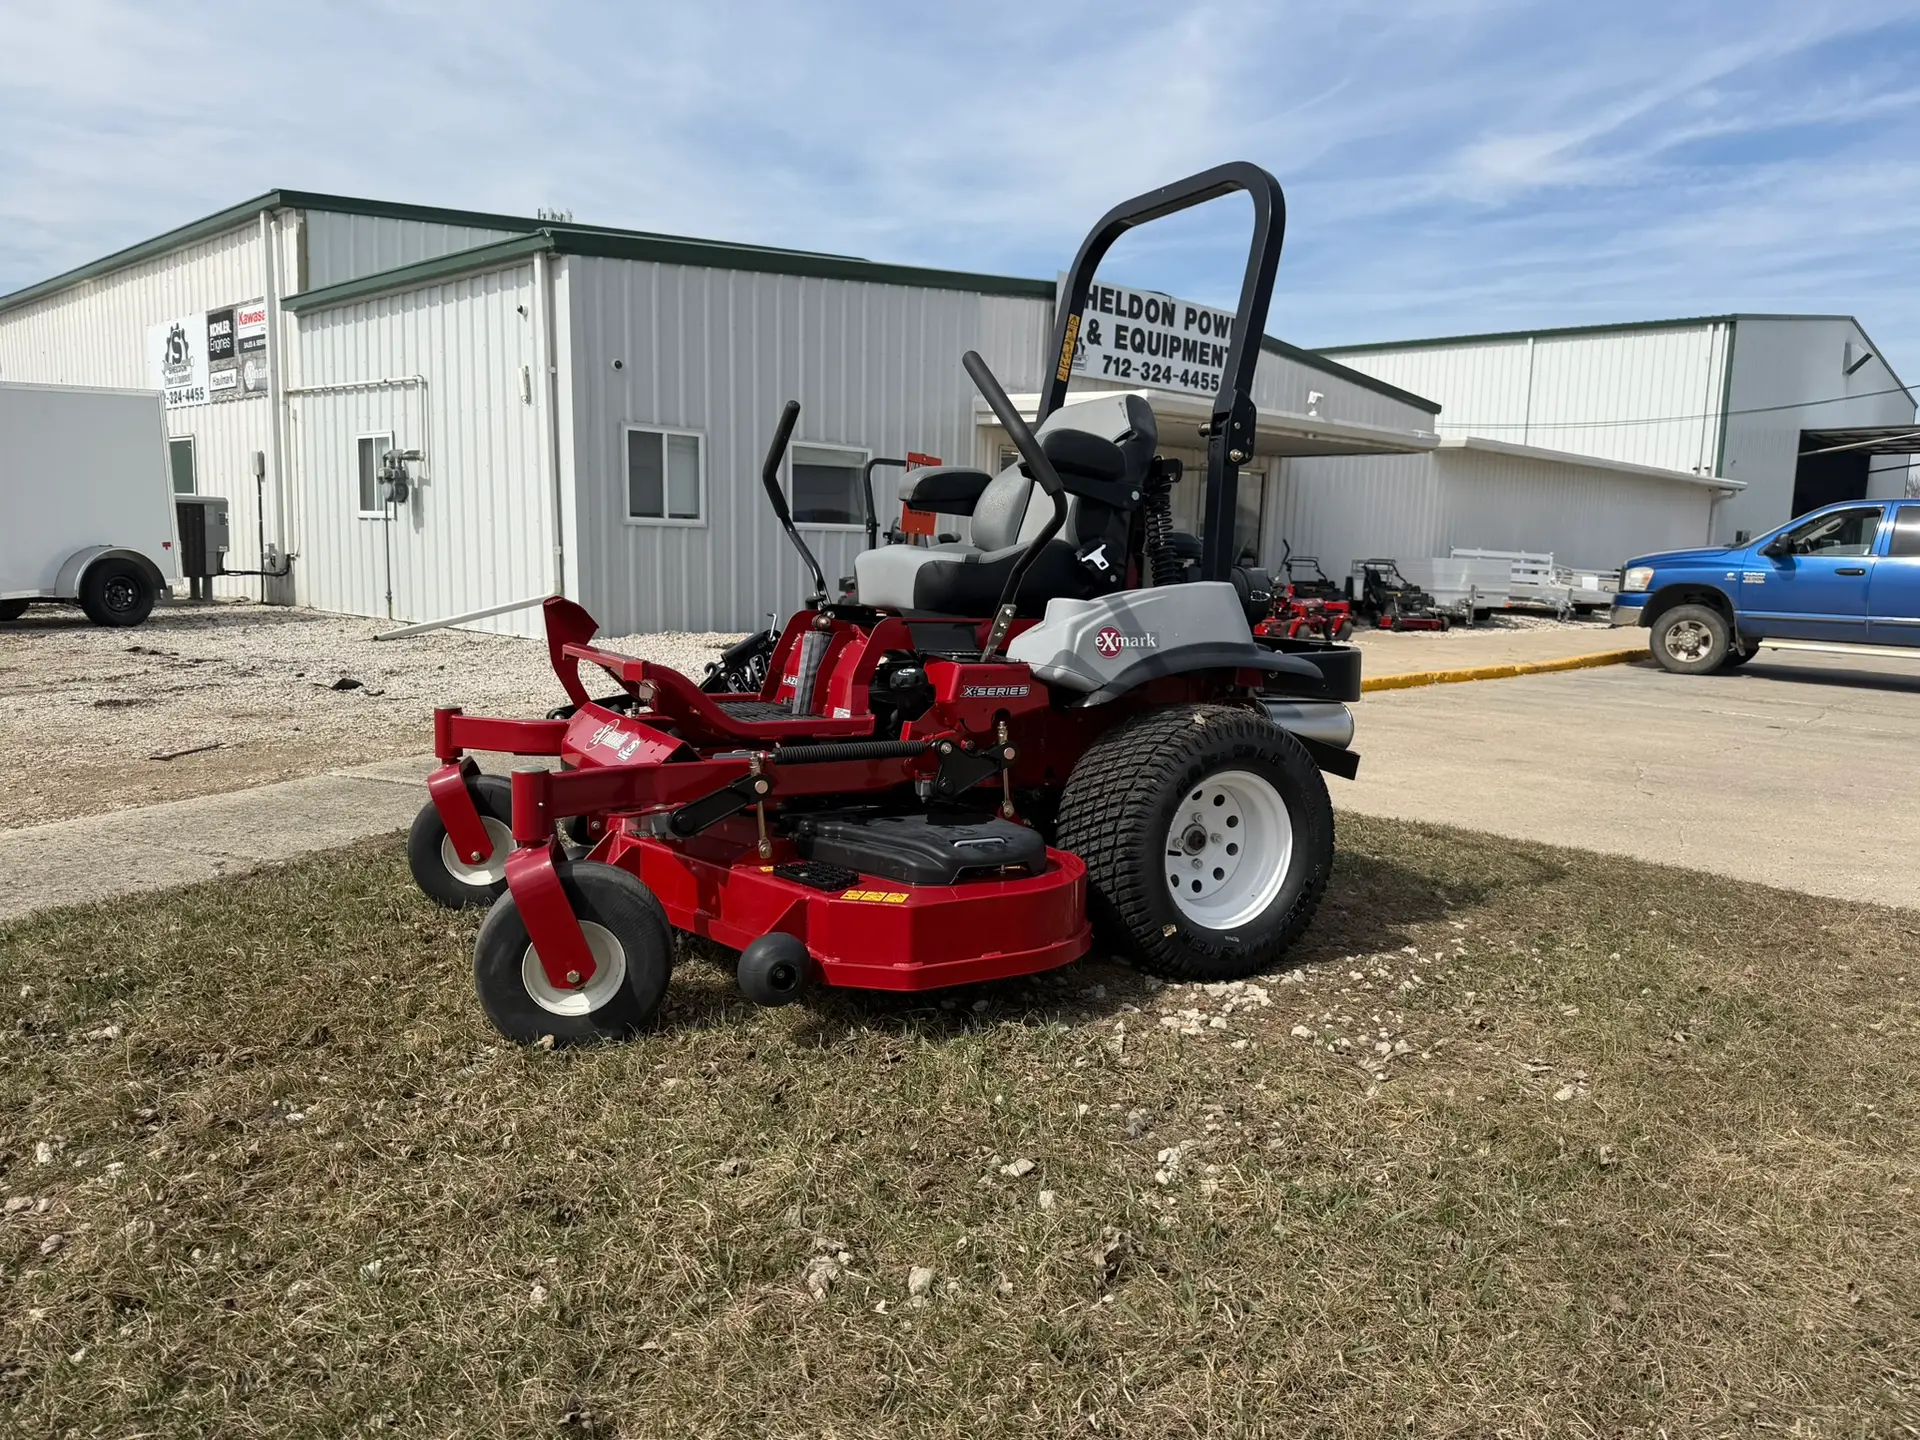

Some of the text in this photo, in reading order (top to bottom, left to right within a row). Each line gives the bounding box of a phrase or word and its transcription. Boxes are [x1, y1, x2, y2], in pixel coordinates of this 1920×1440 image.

[1085, 285, 1176, 328] HELDON
[209, 336, 231, 353] Engines
[1087, 319, 1102, 347] &
[1103, 355, 1220, 392] 712-324-4455
[166, 387, 205, 405] -324-4455
